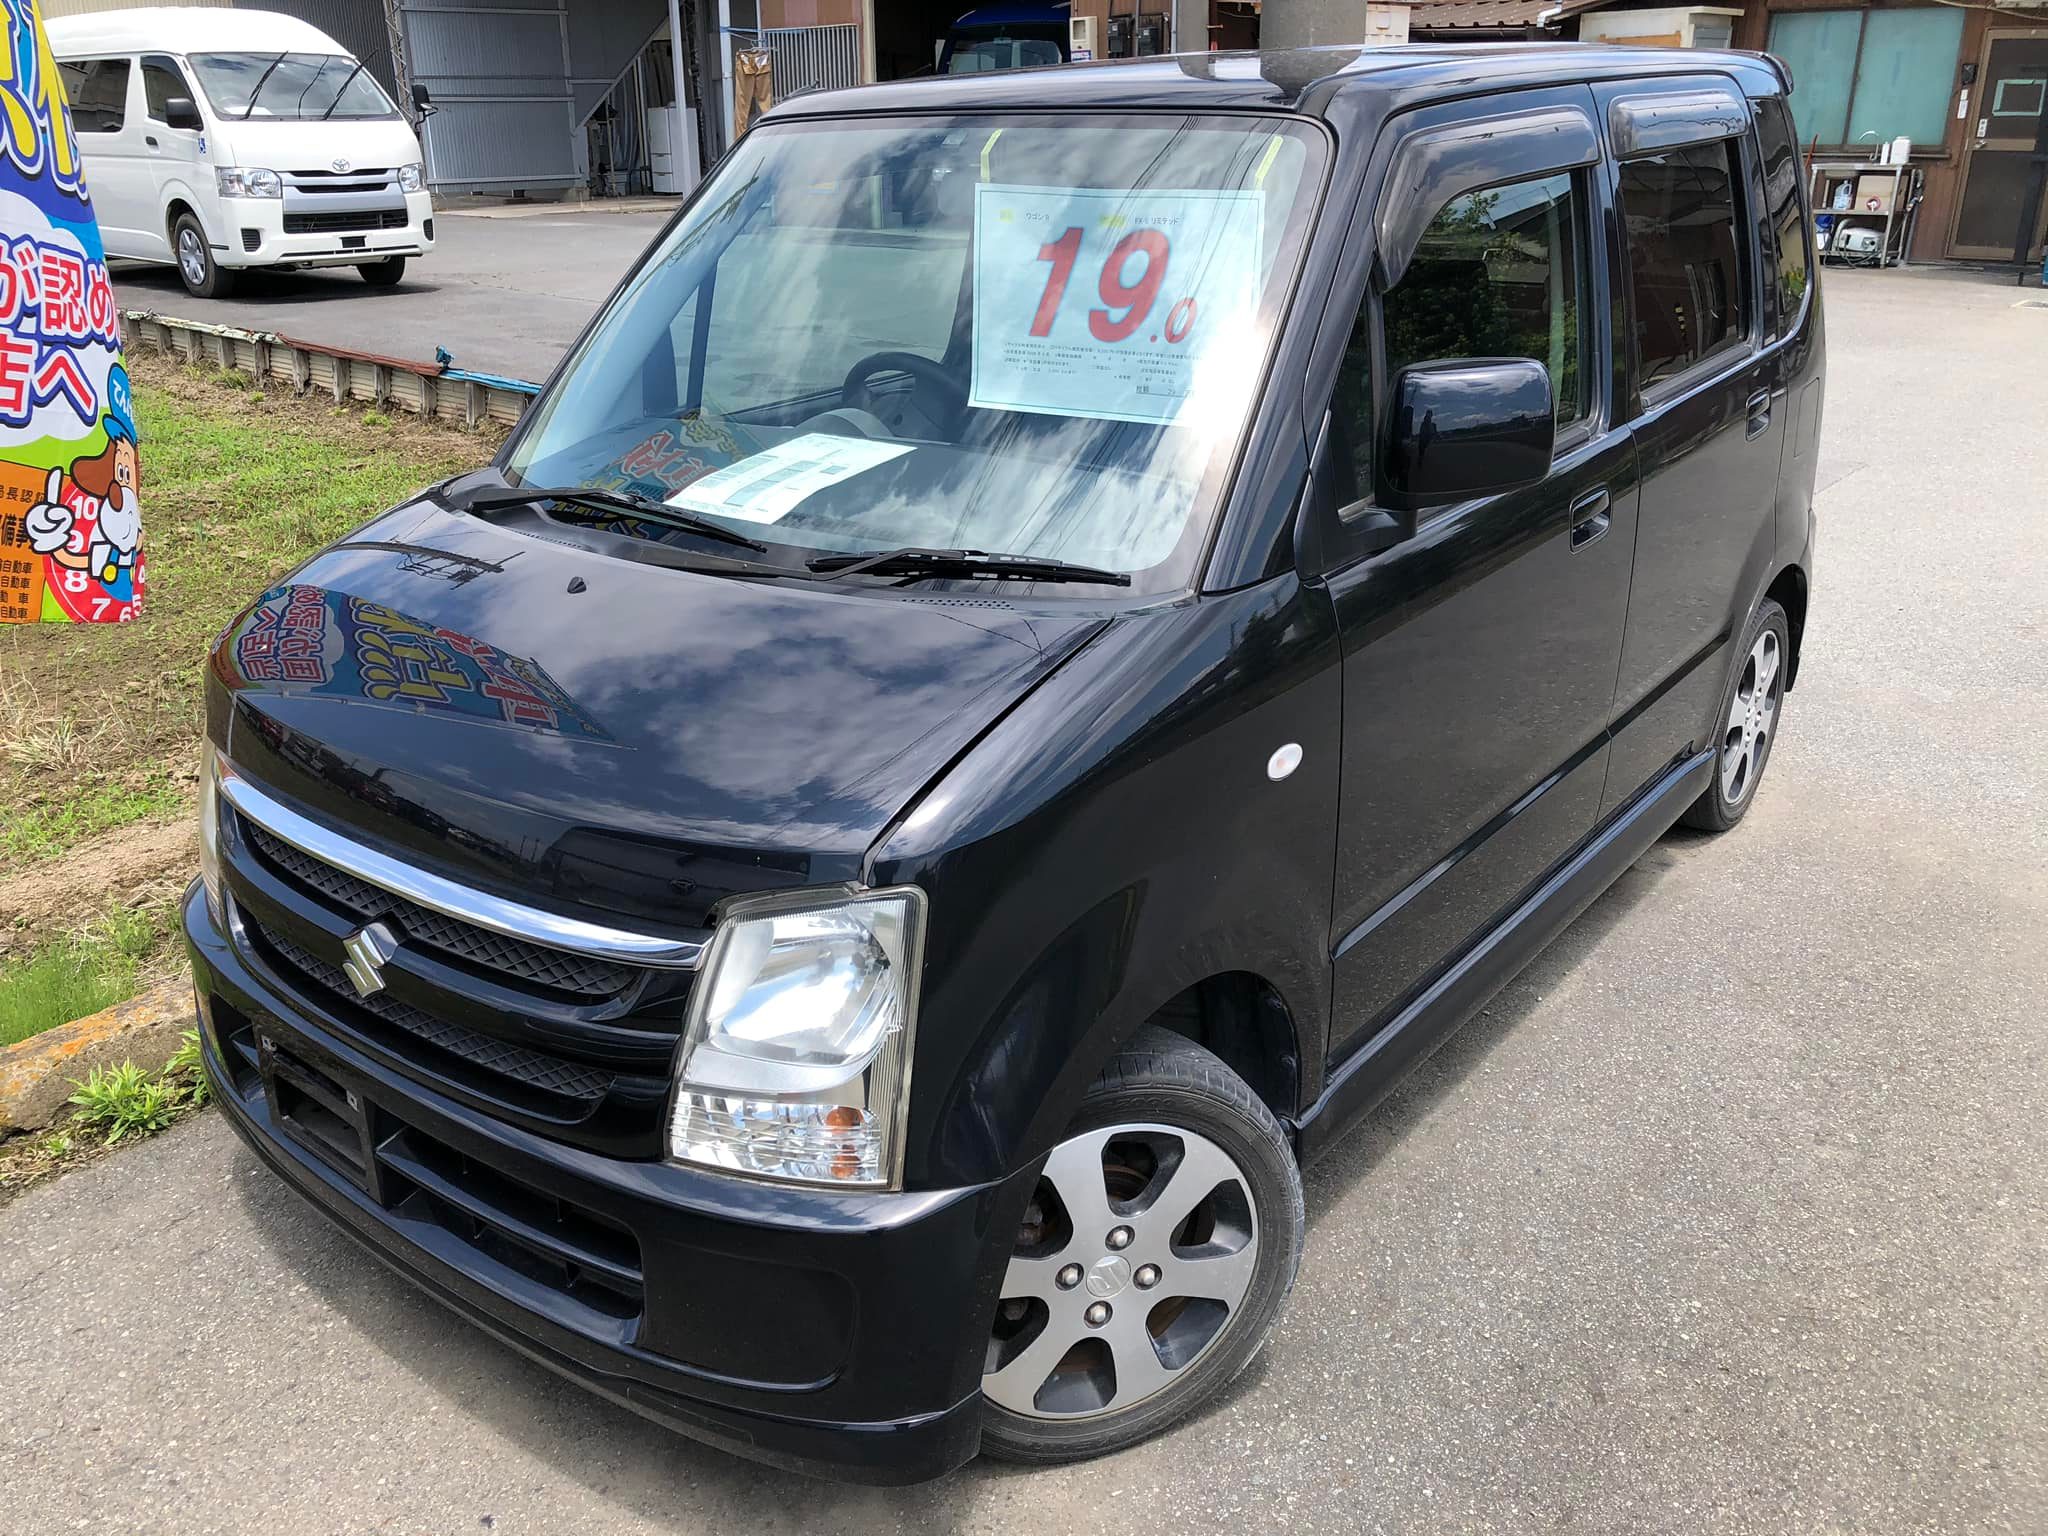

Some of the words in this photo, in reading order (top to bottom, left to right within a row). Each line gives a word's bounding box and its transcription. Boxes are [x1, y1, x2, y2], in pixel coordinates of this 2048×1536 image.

[0, 246, 120, 338] が認め
[1029, 227, 1198, 344] 19.0
[72, 496, 98, 520] 10
[67, 530, 84, 553] 9
[0, 559, 32, 573] 自動車
[64, 570, 88, 593] 8
[92, 598, 112, 620] 7
[120, 606, 131, 622] 6
